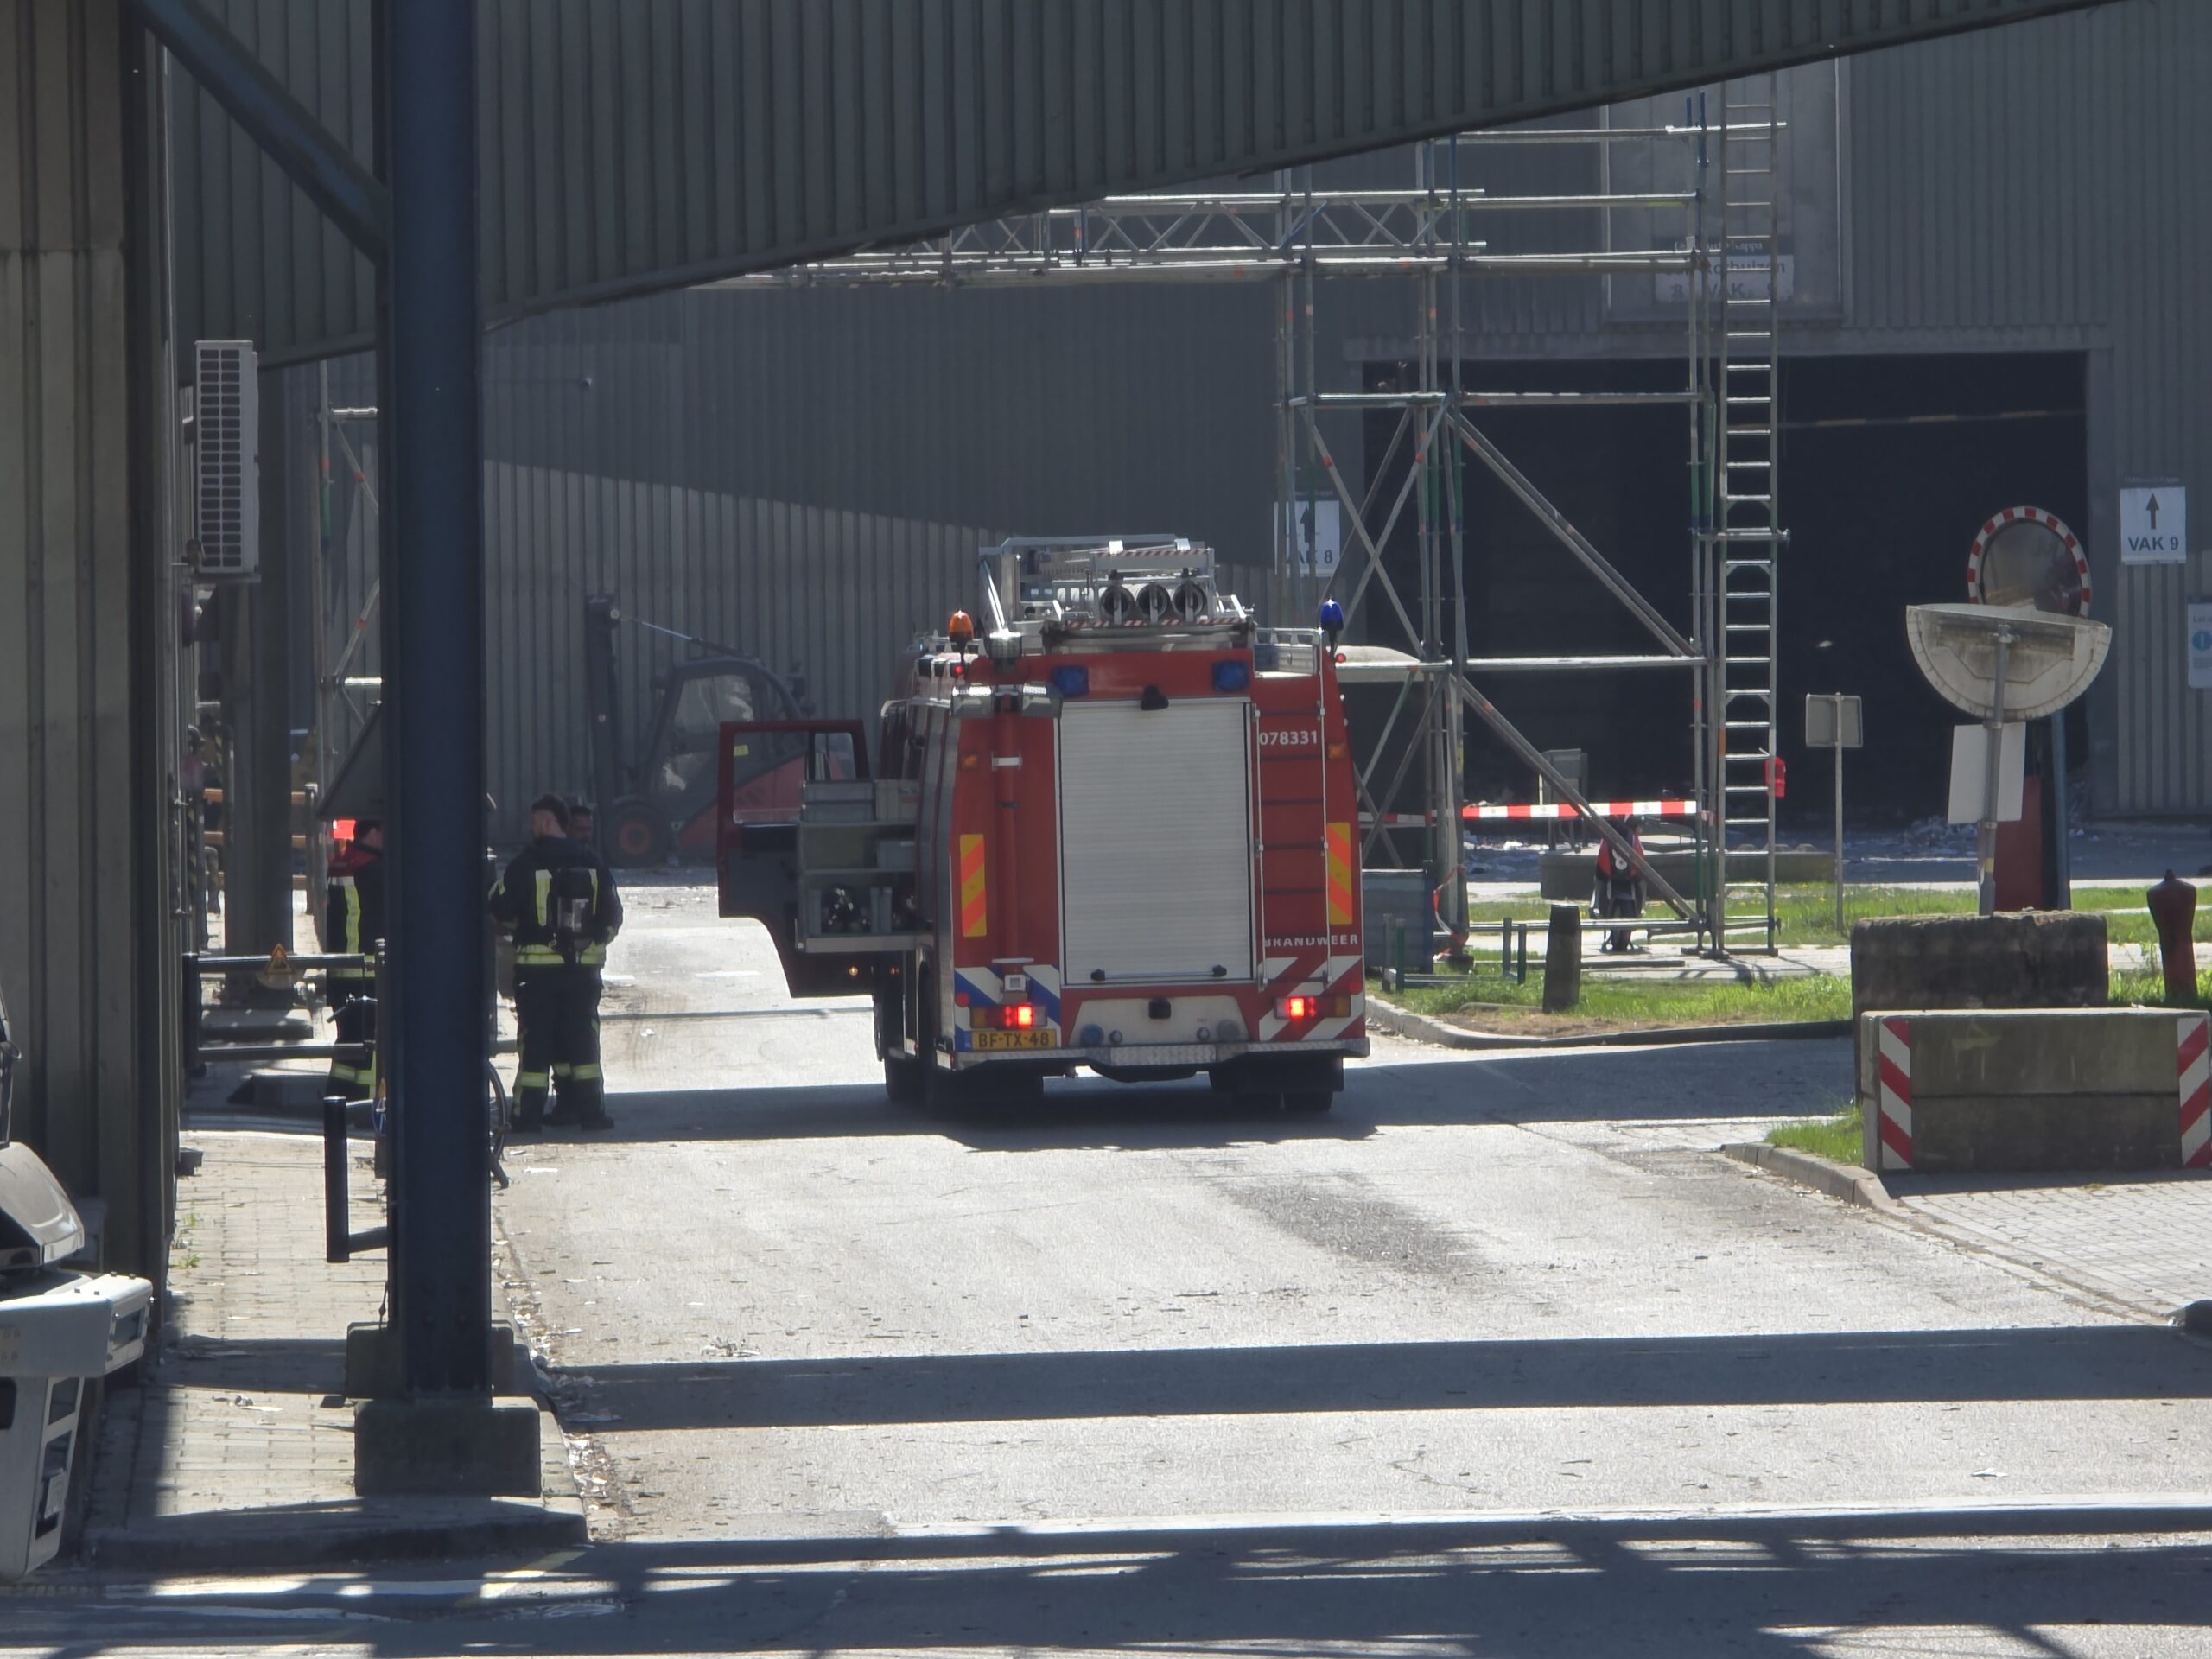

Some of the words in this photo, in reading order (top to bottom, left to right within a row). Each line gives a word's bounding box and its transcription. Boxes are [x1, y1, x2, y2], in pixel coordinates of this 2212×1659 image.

[2128, 537, 2164, 551] VAK
[2170, 536, 2179, 550] 9
[1324, 550, 1332, 564] 8
[1259, 730, 1318, 745] 078331
[978, 1032, 1049, 1047] BF-TX-48
